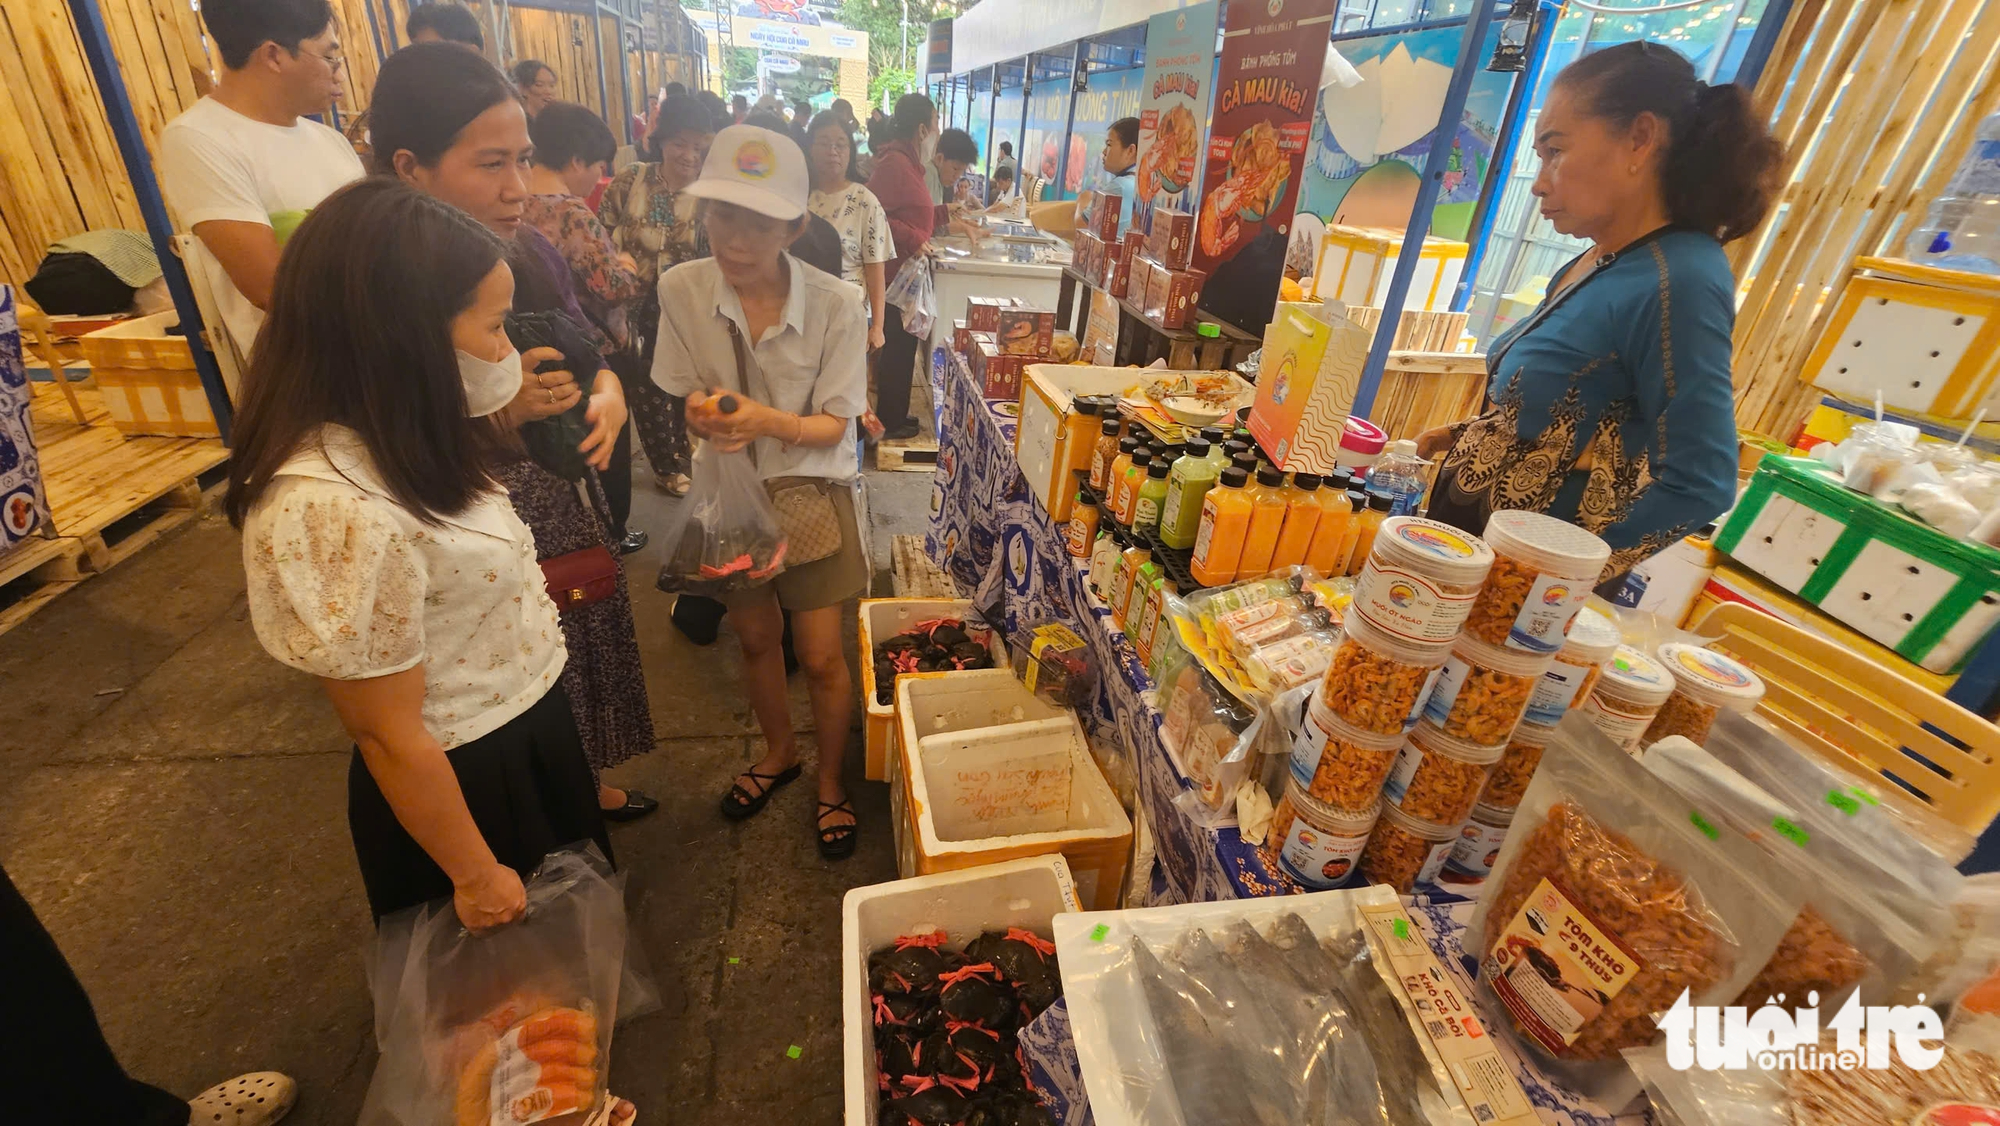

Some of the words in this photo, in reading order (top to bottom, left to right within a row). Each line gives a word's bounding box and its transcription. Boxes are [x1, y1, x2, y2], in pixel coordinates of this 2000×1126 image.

[1240, 54, 1258, 70] BÁNH
[1282, 50, 1297, 65] TÔM
[1046, 90, 1061, 121] MÔI
[1112, 76, 1140, 122] TỈNH
[1153, 73, 1165, 100] CÀ
[1166, 72, 1183, 94] MAU
[1221, 80, 1240, 114] CÀ
[1244, 76, 1277, 104] MAU
[1278, 78, 1308, 115] kìa!
[1618, 586, 1635, 604] 3A
[1564, 916, 1592, 947] TÔM
[1592, 945, 1625, 976] KHÔ
[1569, 942, 1578, 952] 9
[1418, 973, 1437, 997] KHÔ
